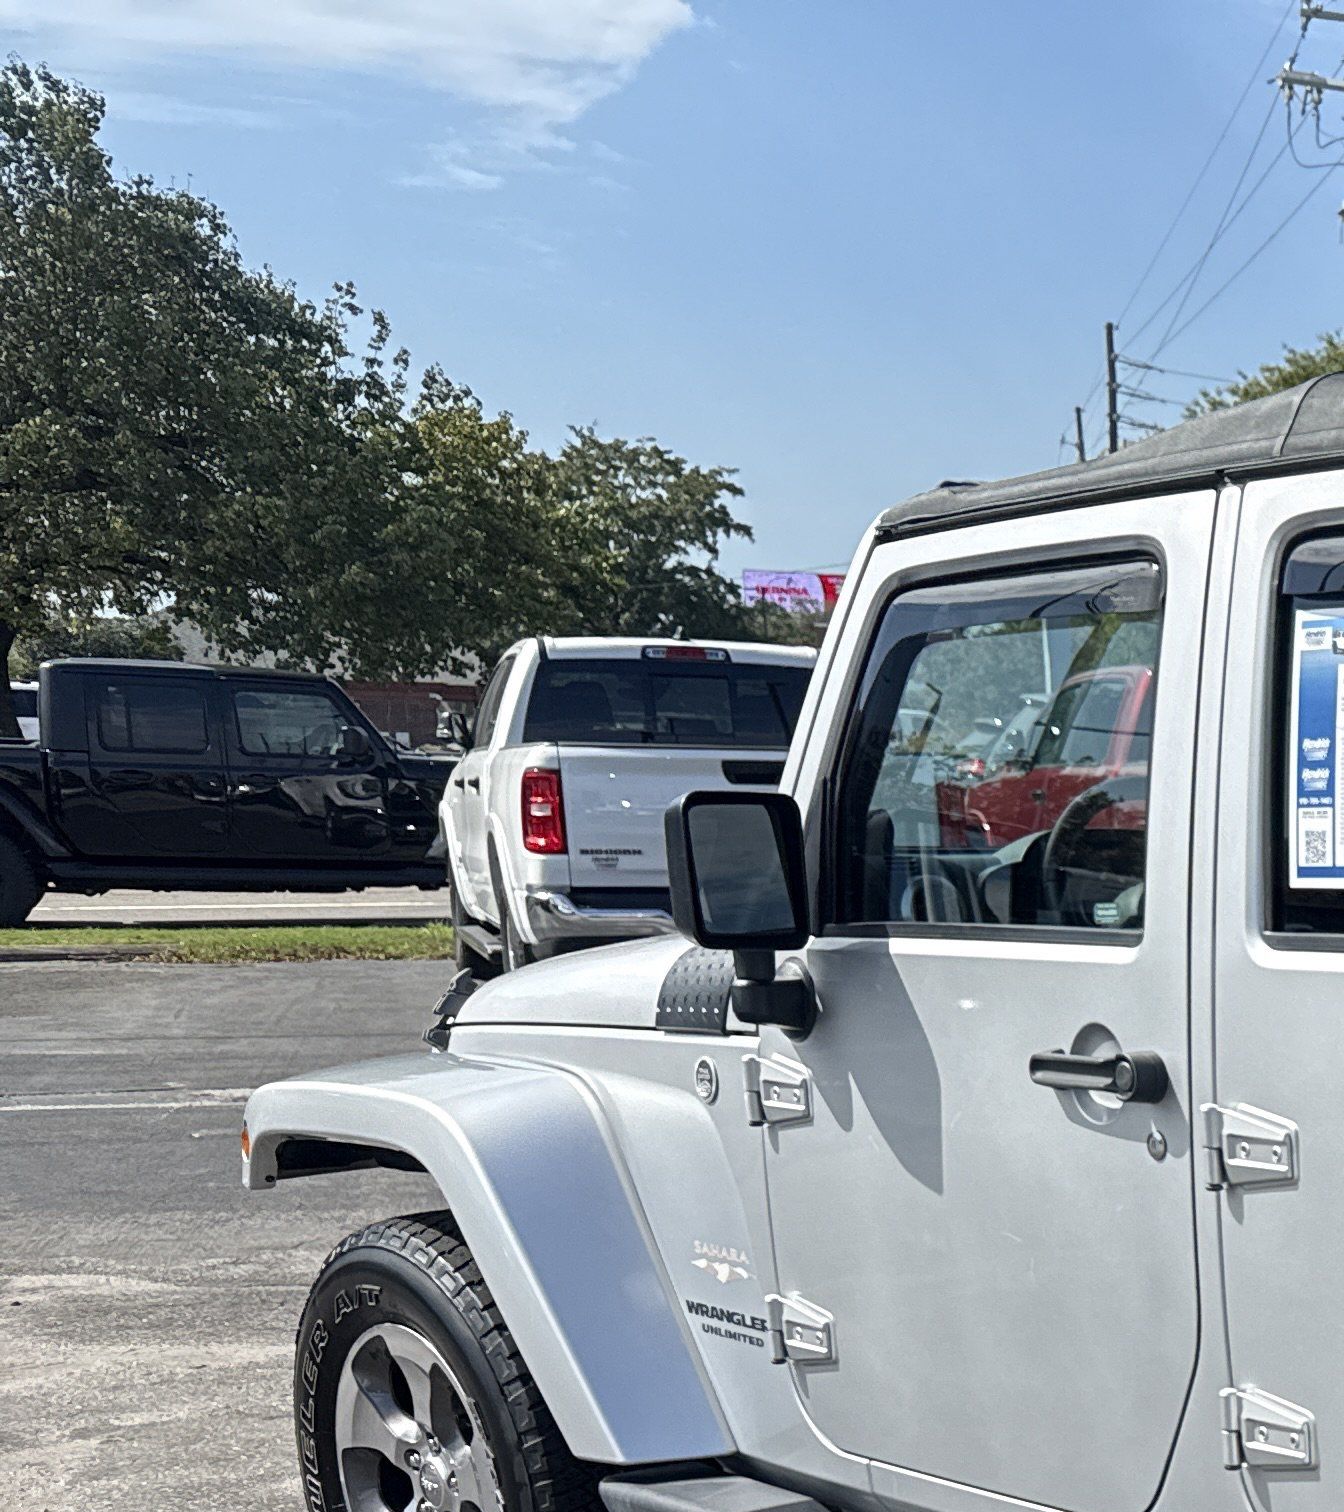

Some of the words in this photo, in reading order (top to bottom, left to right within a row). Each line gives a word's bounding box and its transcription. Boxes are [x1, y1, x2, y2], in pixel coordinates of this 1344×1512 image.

[693, 1240, 749, 1265] SAHARA
[334, 1284, 381, 1323] A/T
[685, 1299, 768, 1333] WRANGLER
[702, 1324, 764, 1348] UNLIMITED
